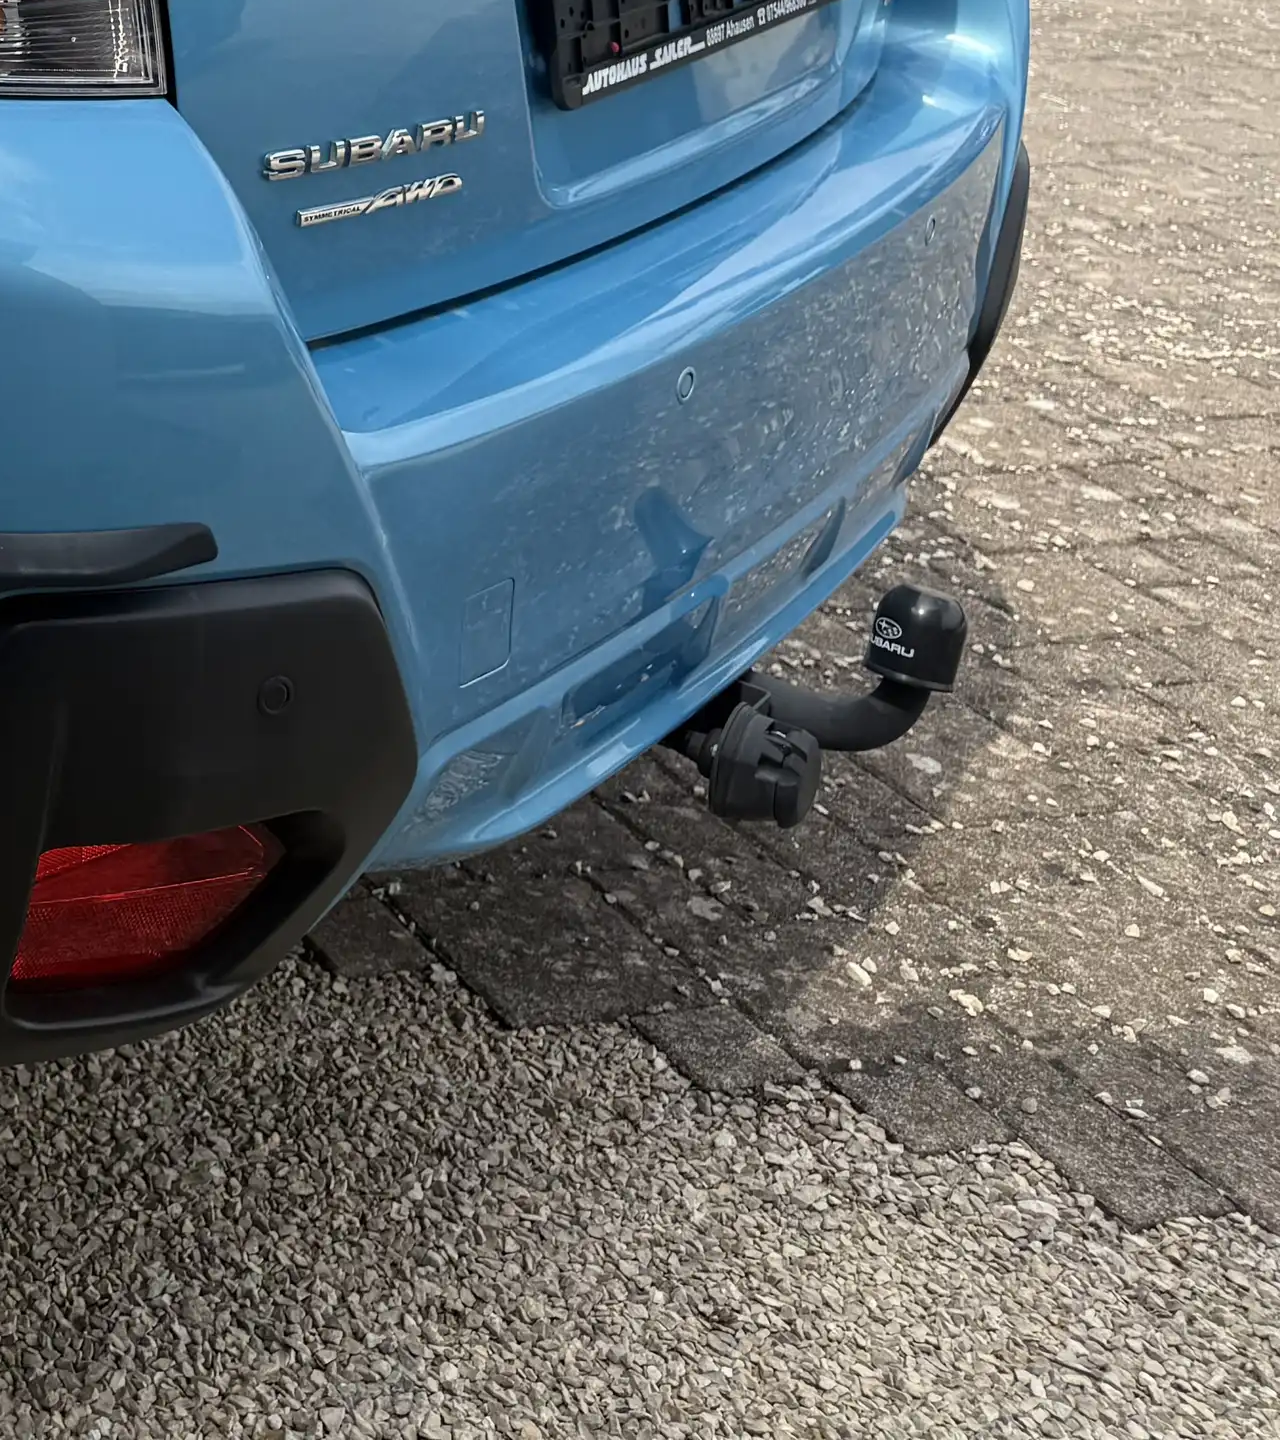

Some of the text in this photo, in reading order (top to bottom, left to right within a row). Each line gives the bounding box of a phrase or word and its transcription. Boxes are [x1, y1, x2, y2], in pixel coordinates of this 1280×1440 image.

[582, 53, 648, 96] AUTOHAUS
[649, 36, 706, 71] SAILER
[726, 15, 755, 39] Ahausen
[261, 110, 486, 181] SUBARU
[303, 172, 464, 223] SYMMETRICAL AWD
[870, 635, 915, 659] UBARU
